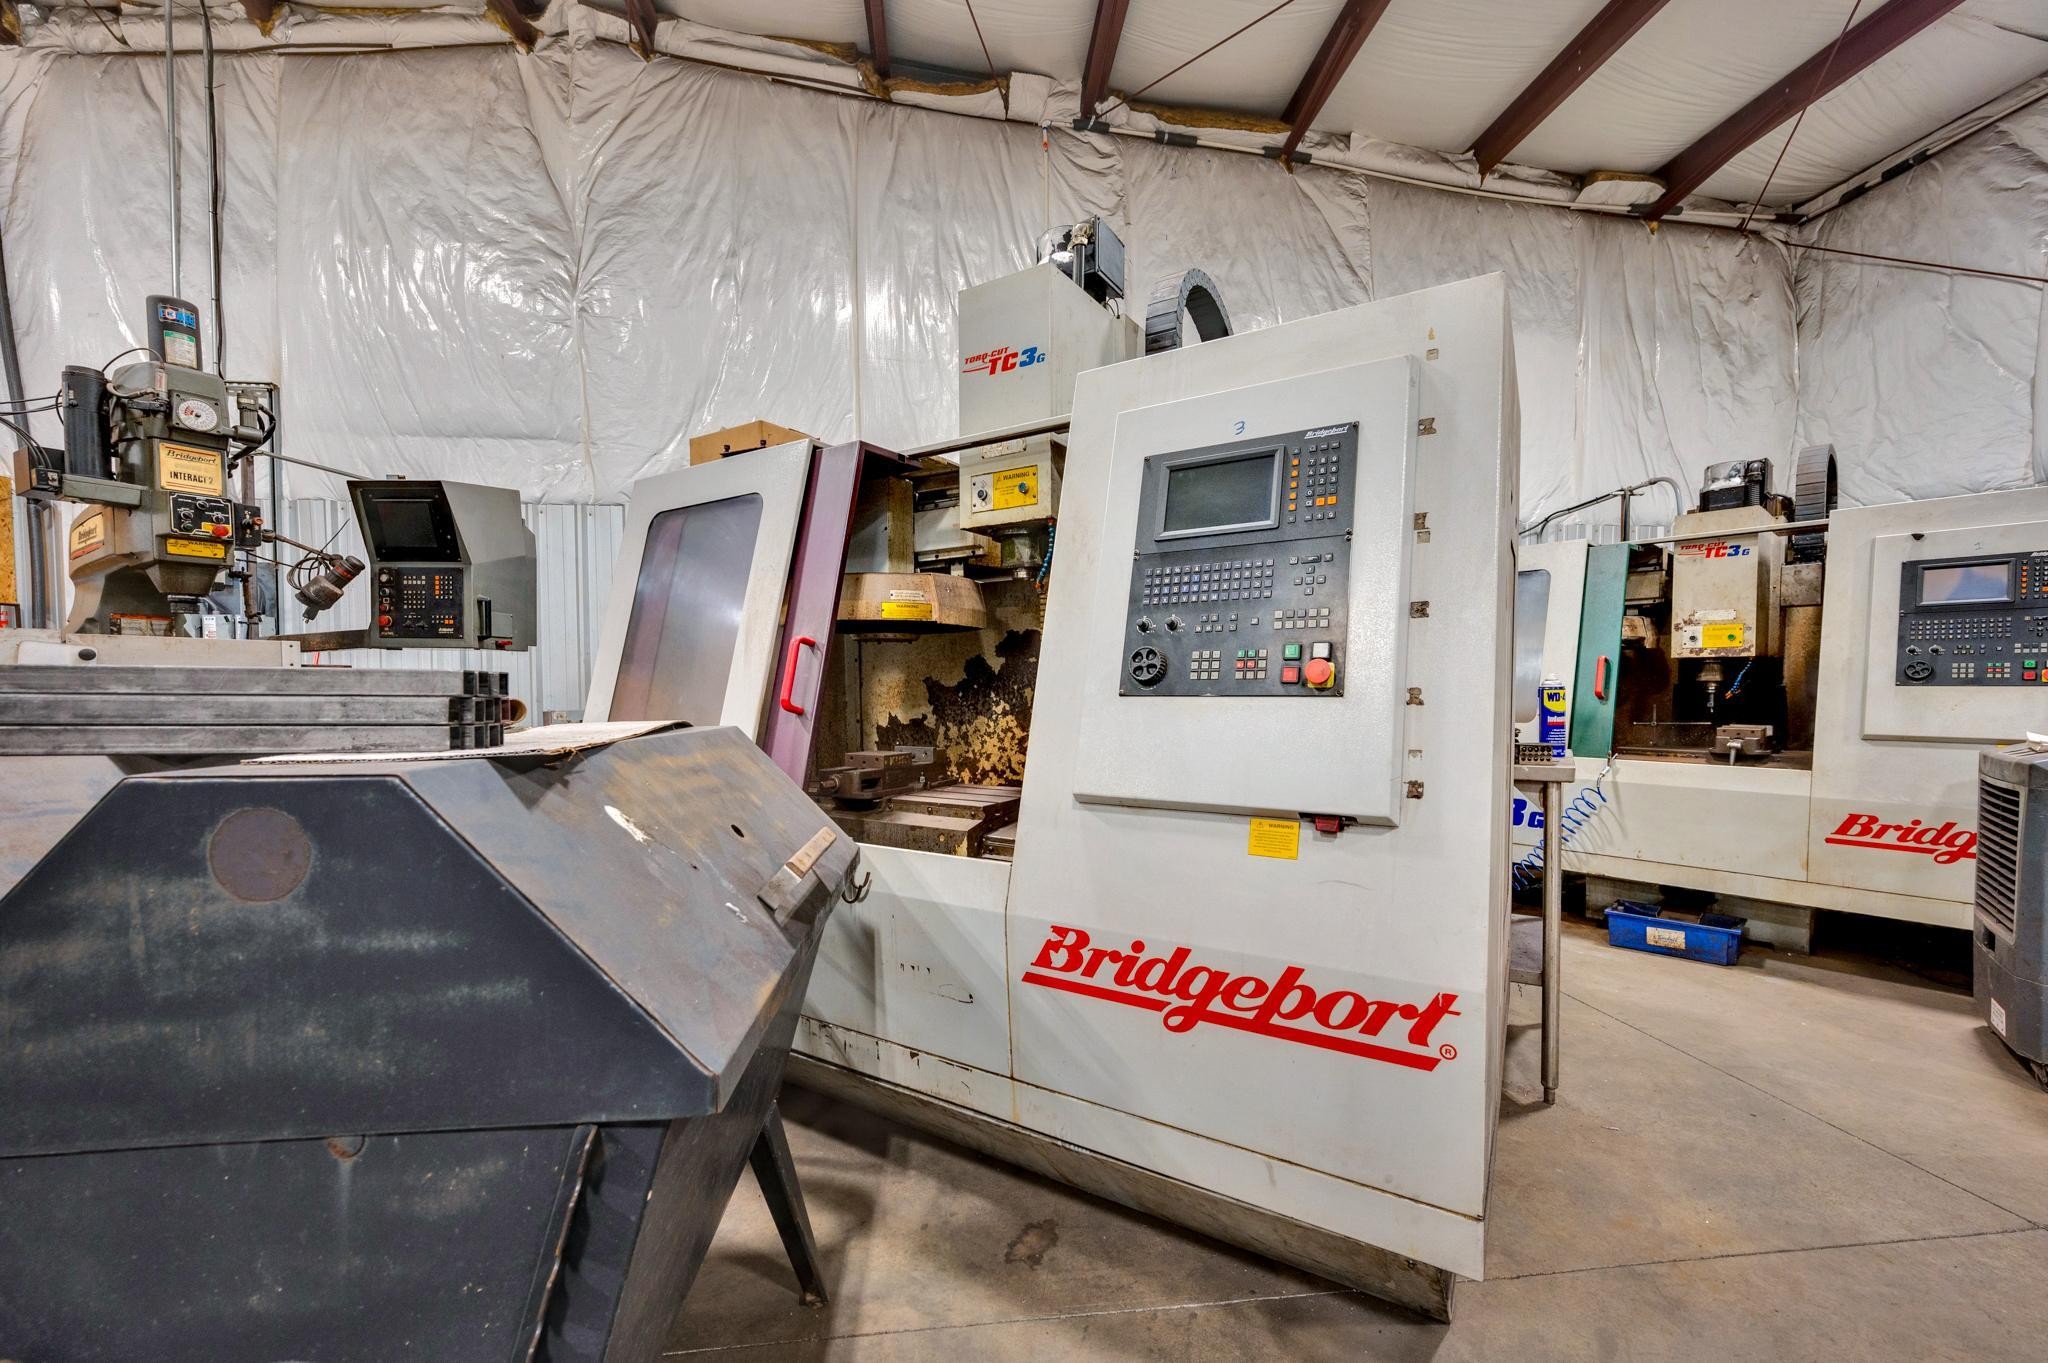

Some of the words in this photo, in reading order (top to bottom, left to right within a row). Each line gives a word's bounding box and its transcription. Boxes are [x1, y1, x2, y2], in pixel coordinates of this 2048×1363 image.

[965, 346, 1009, 364] TORQ-CUT
[1233, 420, 1246, 436] 3
[1304, 425, 1349, 438] Bridgeport
[167, 449, 217, 464] Bridgeport
[170, 471, 207, 484] INTERACT
[1003, 471, 1030, 481] WARNING
[1028, 925, 1461, 1047] Bridgeport
